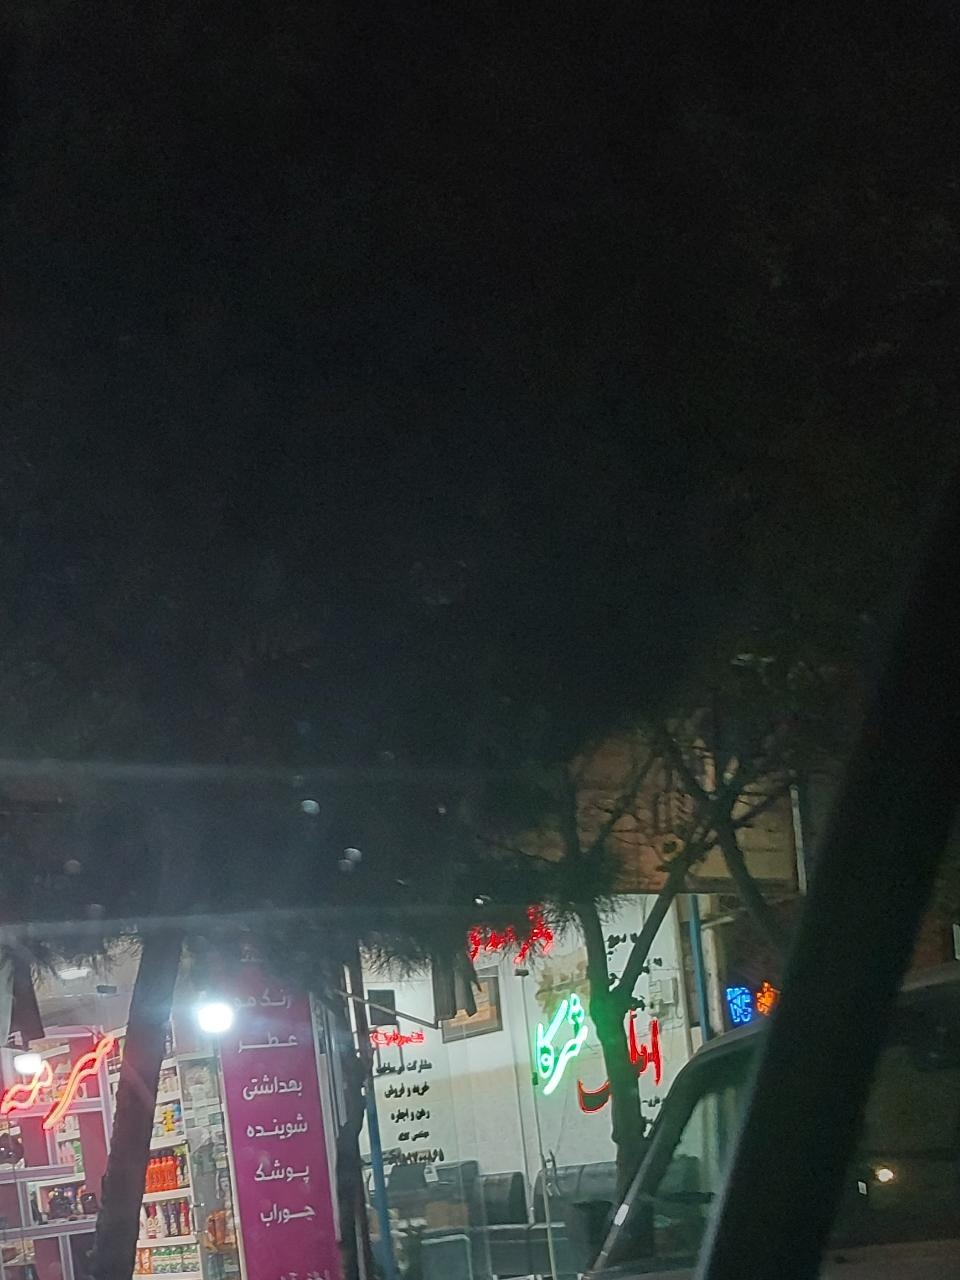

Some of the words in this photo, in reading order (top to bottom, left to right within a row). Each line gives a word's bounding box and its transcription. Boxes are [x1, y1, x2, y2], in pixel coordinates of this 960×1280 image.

[239, 1031, 299, 1053] عطر
[242, 1074, 303, 1101] بهداشتی
[246, 1112, 309, 1140] شوینده
[254, 1159, 310, 1184] پوشک
[260, 1203, 316, 1227] جوراب
